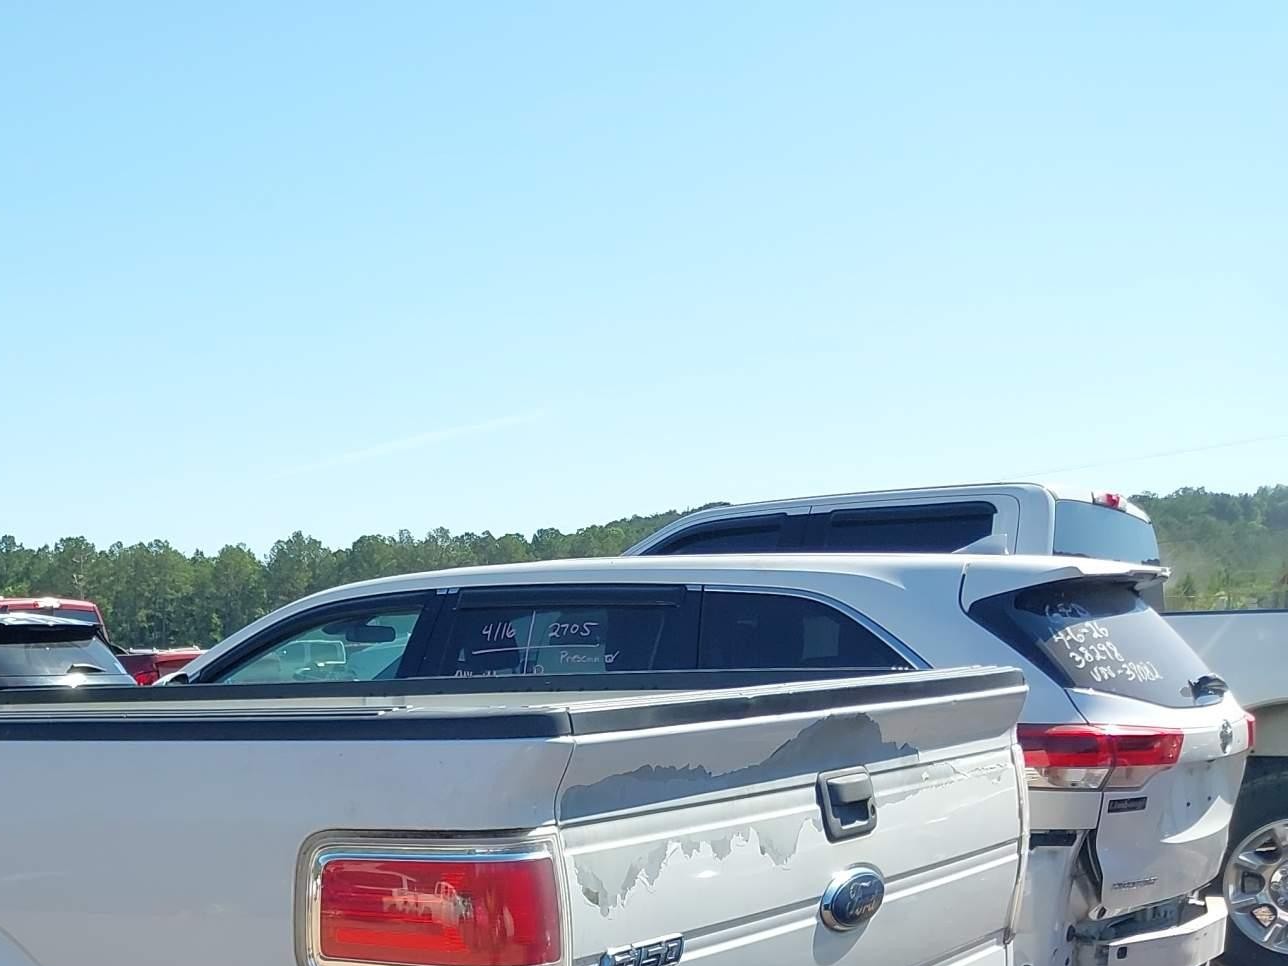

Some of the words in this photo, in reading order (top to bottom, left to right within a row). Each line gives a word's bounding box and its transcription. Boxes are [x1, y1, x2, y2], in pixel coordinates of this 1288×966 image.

[482, 622, 517, 641] 4/16
[548, 622, 599, 638] 2705
[846, 880, 880, 917] Ford
